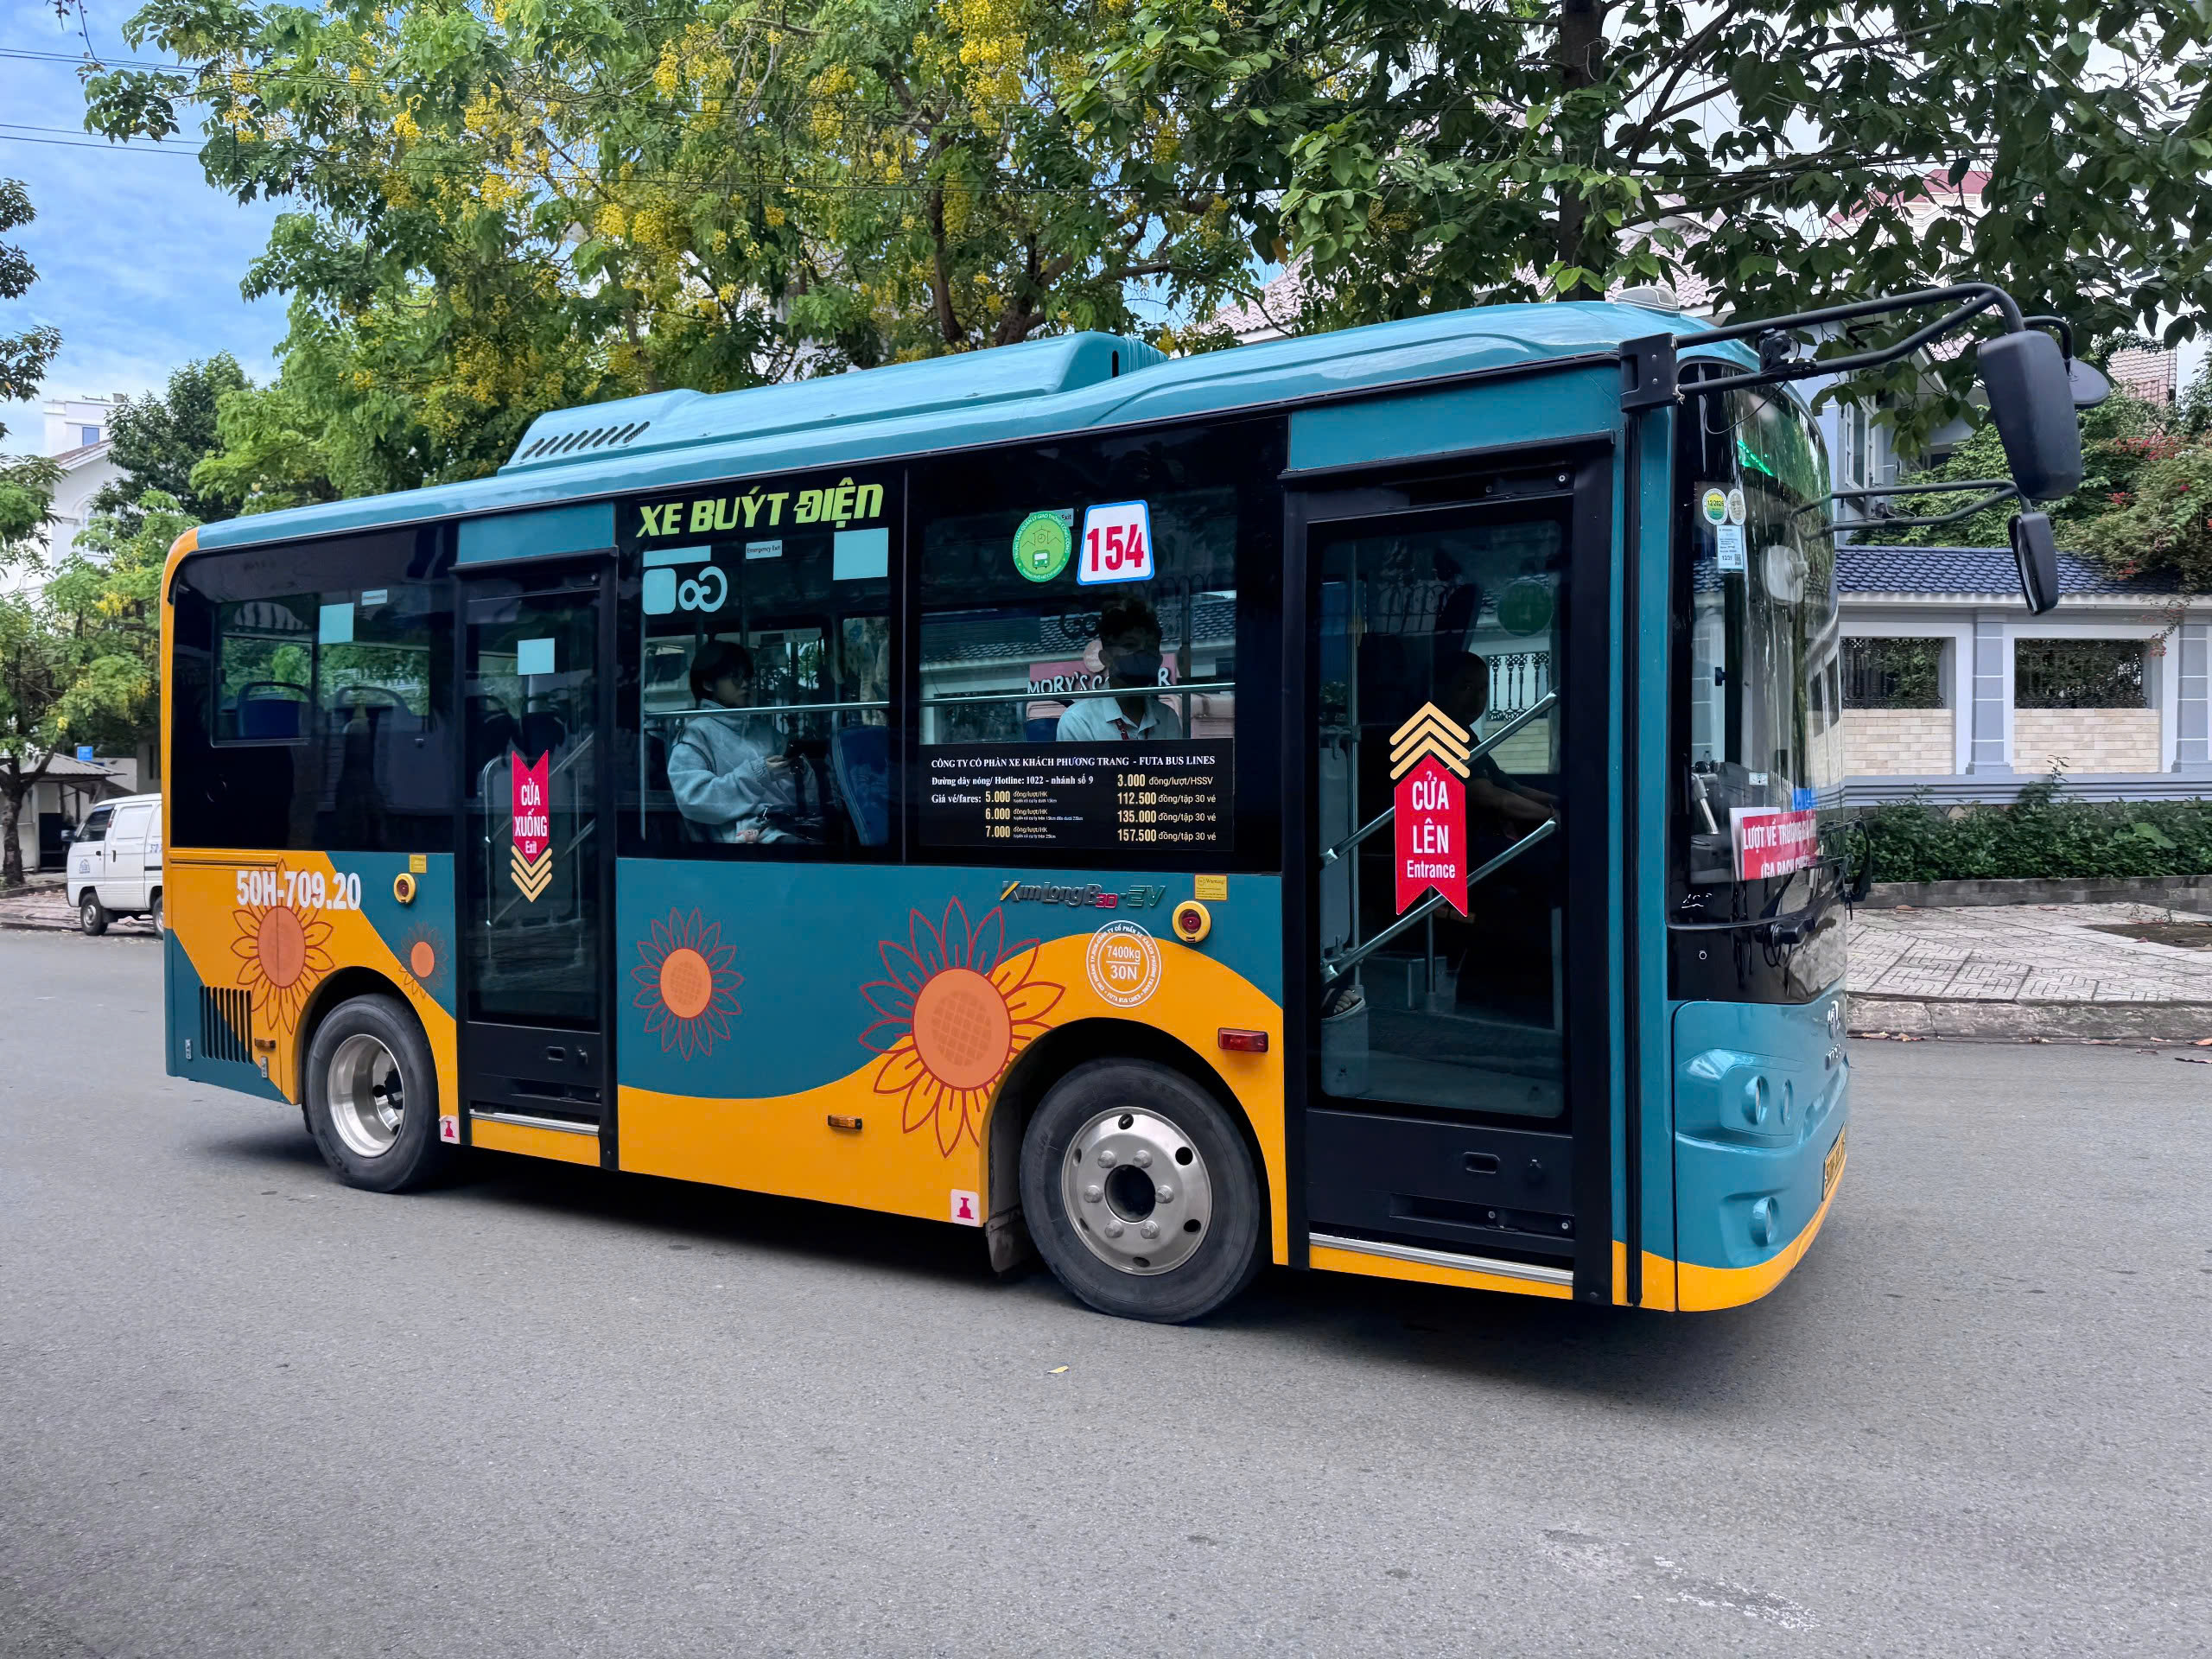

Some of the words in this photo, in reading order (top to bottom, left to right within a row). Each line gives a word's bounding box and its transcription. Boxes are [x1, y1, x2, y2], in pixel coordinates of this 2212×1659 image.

[636, 503, 683, 538] XE
[690, 486, 790, 533] BUÝT
[1087, 524, 1144, 572] 154
[931, 758, 956, 768] CÔNG
[957, 759, 969, 767] TY
[1008, 758, 1020, 767] XE
[1022, 756, 1054, 766] KHÁCH
[1056, 757, 1095, 766] PHƯƠNG
[1096, 757, 1129, 766] TRANG
[1139, 756, 1164, 766] FUTA
[1166, 756, 1184, 765] BUS
[1186, 756, 1216, 765] LINES
[931, 777, 957, 787] Đường
[957, 777, 970, 787] dây
[1026, 776, 1044, 785] 1022
[1052, 776, 1076, 785] nhánh
[1077, 773, 1086, 785] số
[1089, 776, 1094, 785] 9
[1117, 773, 1146, 787] 3.000
[521, 777, 541, 806] CỬA
[931, 792, 946, 804] Giá
[947, 793, 982, 804] vé/fares:
[985, 791, 1011, 803] 5.000
[1117, 791, 1157, 804] 112.500
[1195, 794, 1205, 803] 30
[1206, 794, 1217, 803] vé
[1412, 771, 1450, 810] CỬA
[985, 807, 1010, 820] 6.000
[1117, 810, 1157, 823] 135.000
[1195, 812, 1205, 822] 30
[1206, 812, 1217, 821] vé
[514, 808, 548, 837] XUỐNG
[985, 825, 1010, 838] 7.000
[1117, 829, 1157, 842] 157.500
[1195, 832, 1205, 841] 30
[1206, 831, 1217, 841] vé
[1413, 817, 1450, 855] LÊN
[1744, 824, 1765, 854] LƯỢT
[1407, 860, 1456, 879] Entrance
[236, 870, 362, 911] 50H-709.20
[1107, 945, 1141, 962] 7400kg
[1110, 964, 1137, 980] 30N
